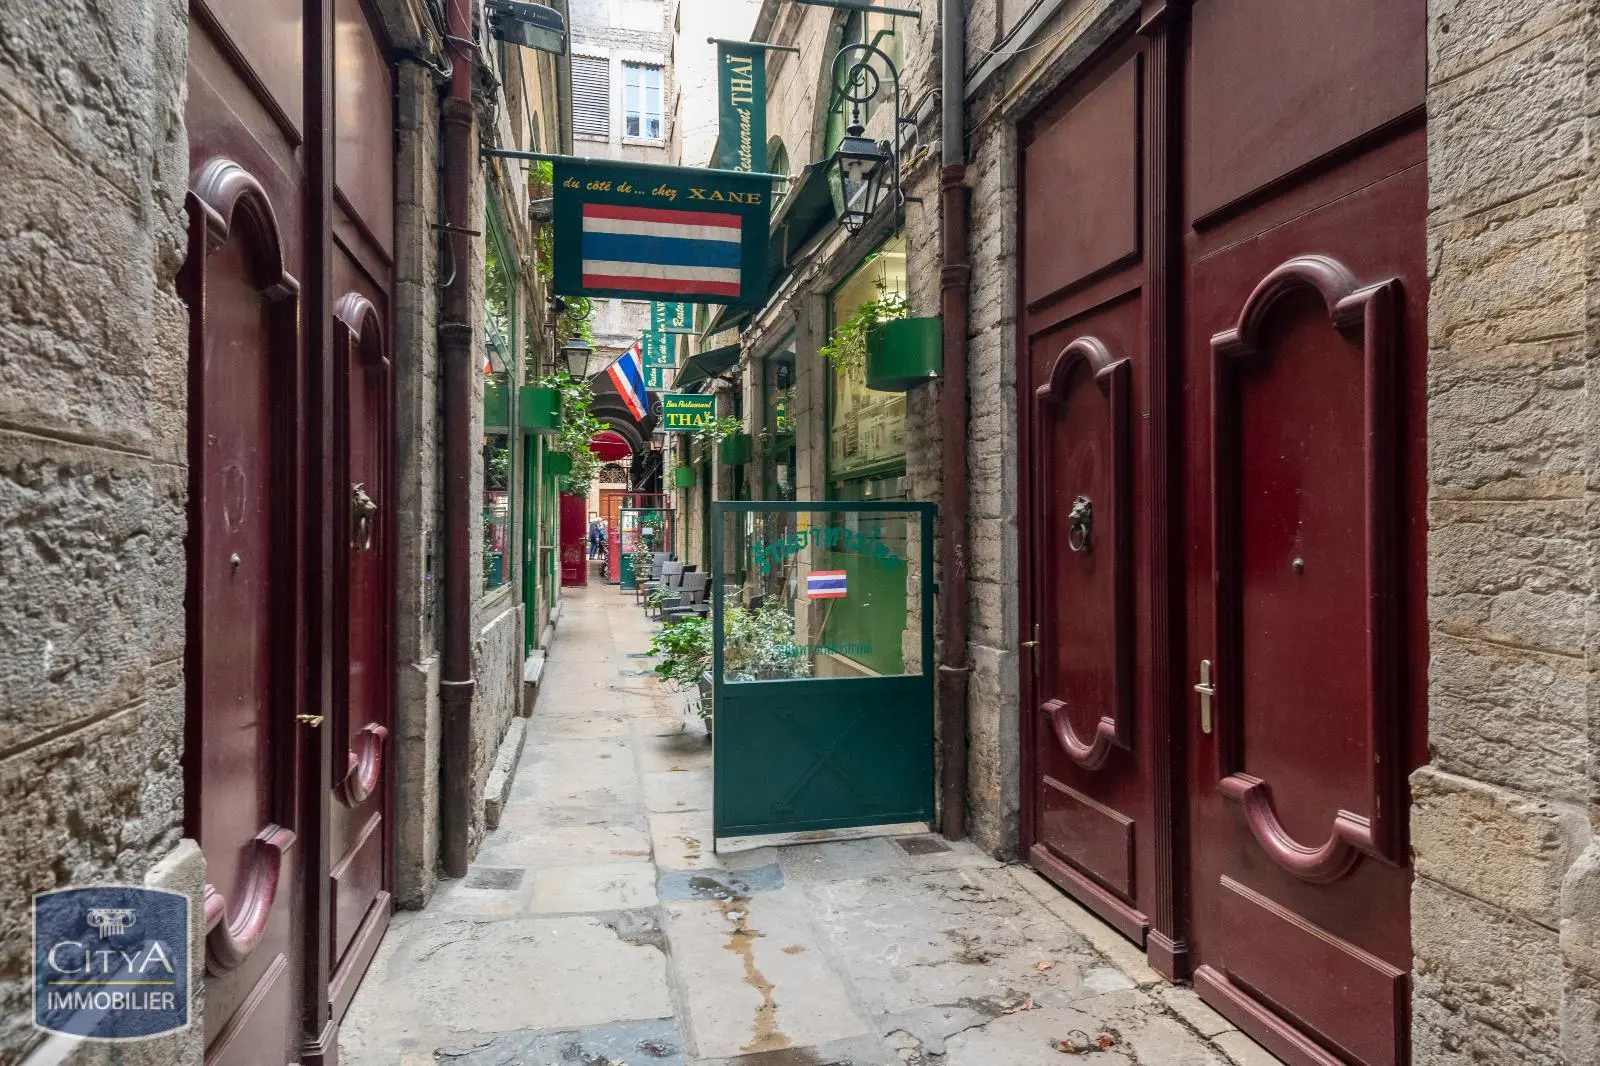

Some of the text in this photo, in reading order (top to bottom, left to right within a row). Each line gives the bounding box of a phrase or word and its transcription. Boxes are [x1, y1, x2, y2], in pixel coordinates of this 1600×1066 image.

[726, 55, 753, 105] THAÏ
[563, 177, 581, 189] du
[652, 184, 678, 201] chez
[688, 188, 762, 205] XANE
[666, 400, 677, 408] Bar
[667, 411, 711, 426] THAÏ
